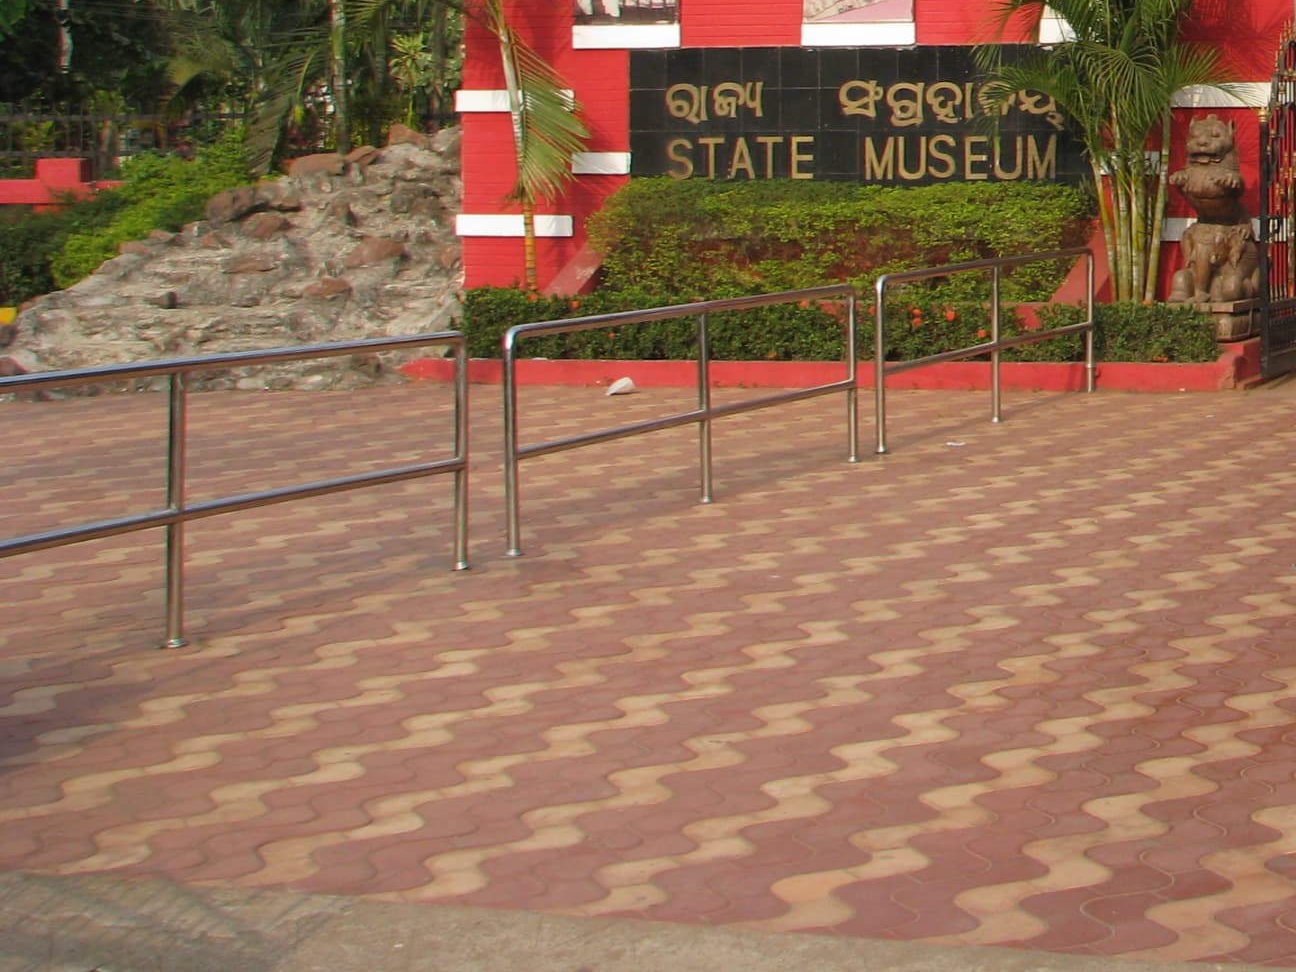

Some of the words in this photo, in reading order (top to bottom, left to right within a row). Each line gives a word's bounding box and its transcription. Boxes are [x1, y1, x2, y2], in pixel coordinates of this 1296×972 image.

[664, 79, 764, 125] ରାଜ୍ୟ
[666, 134, 815, 181] STATE
[864, 133, 1057, 182] MUSEUM
